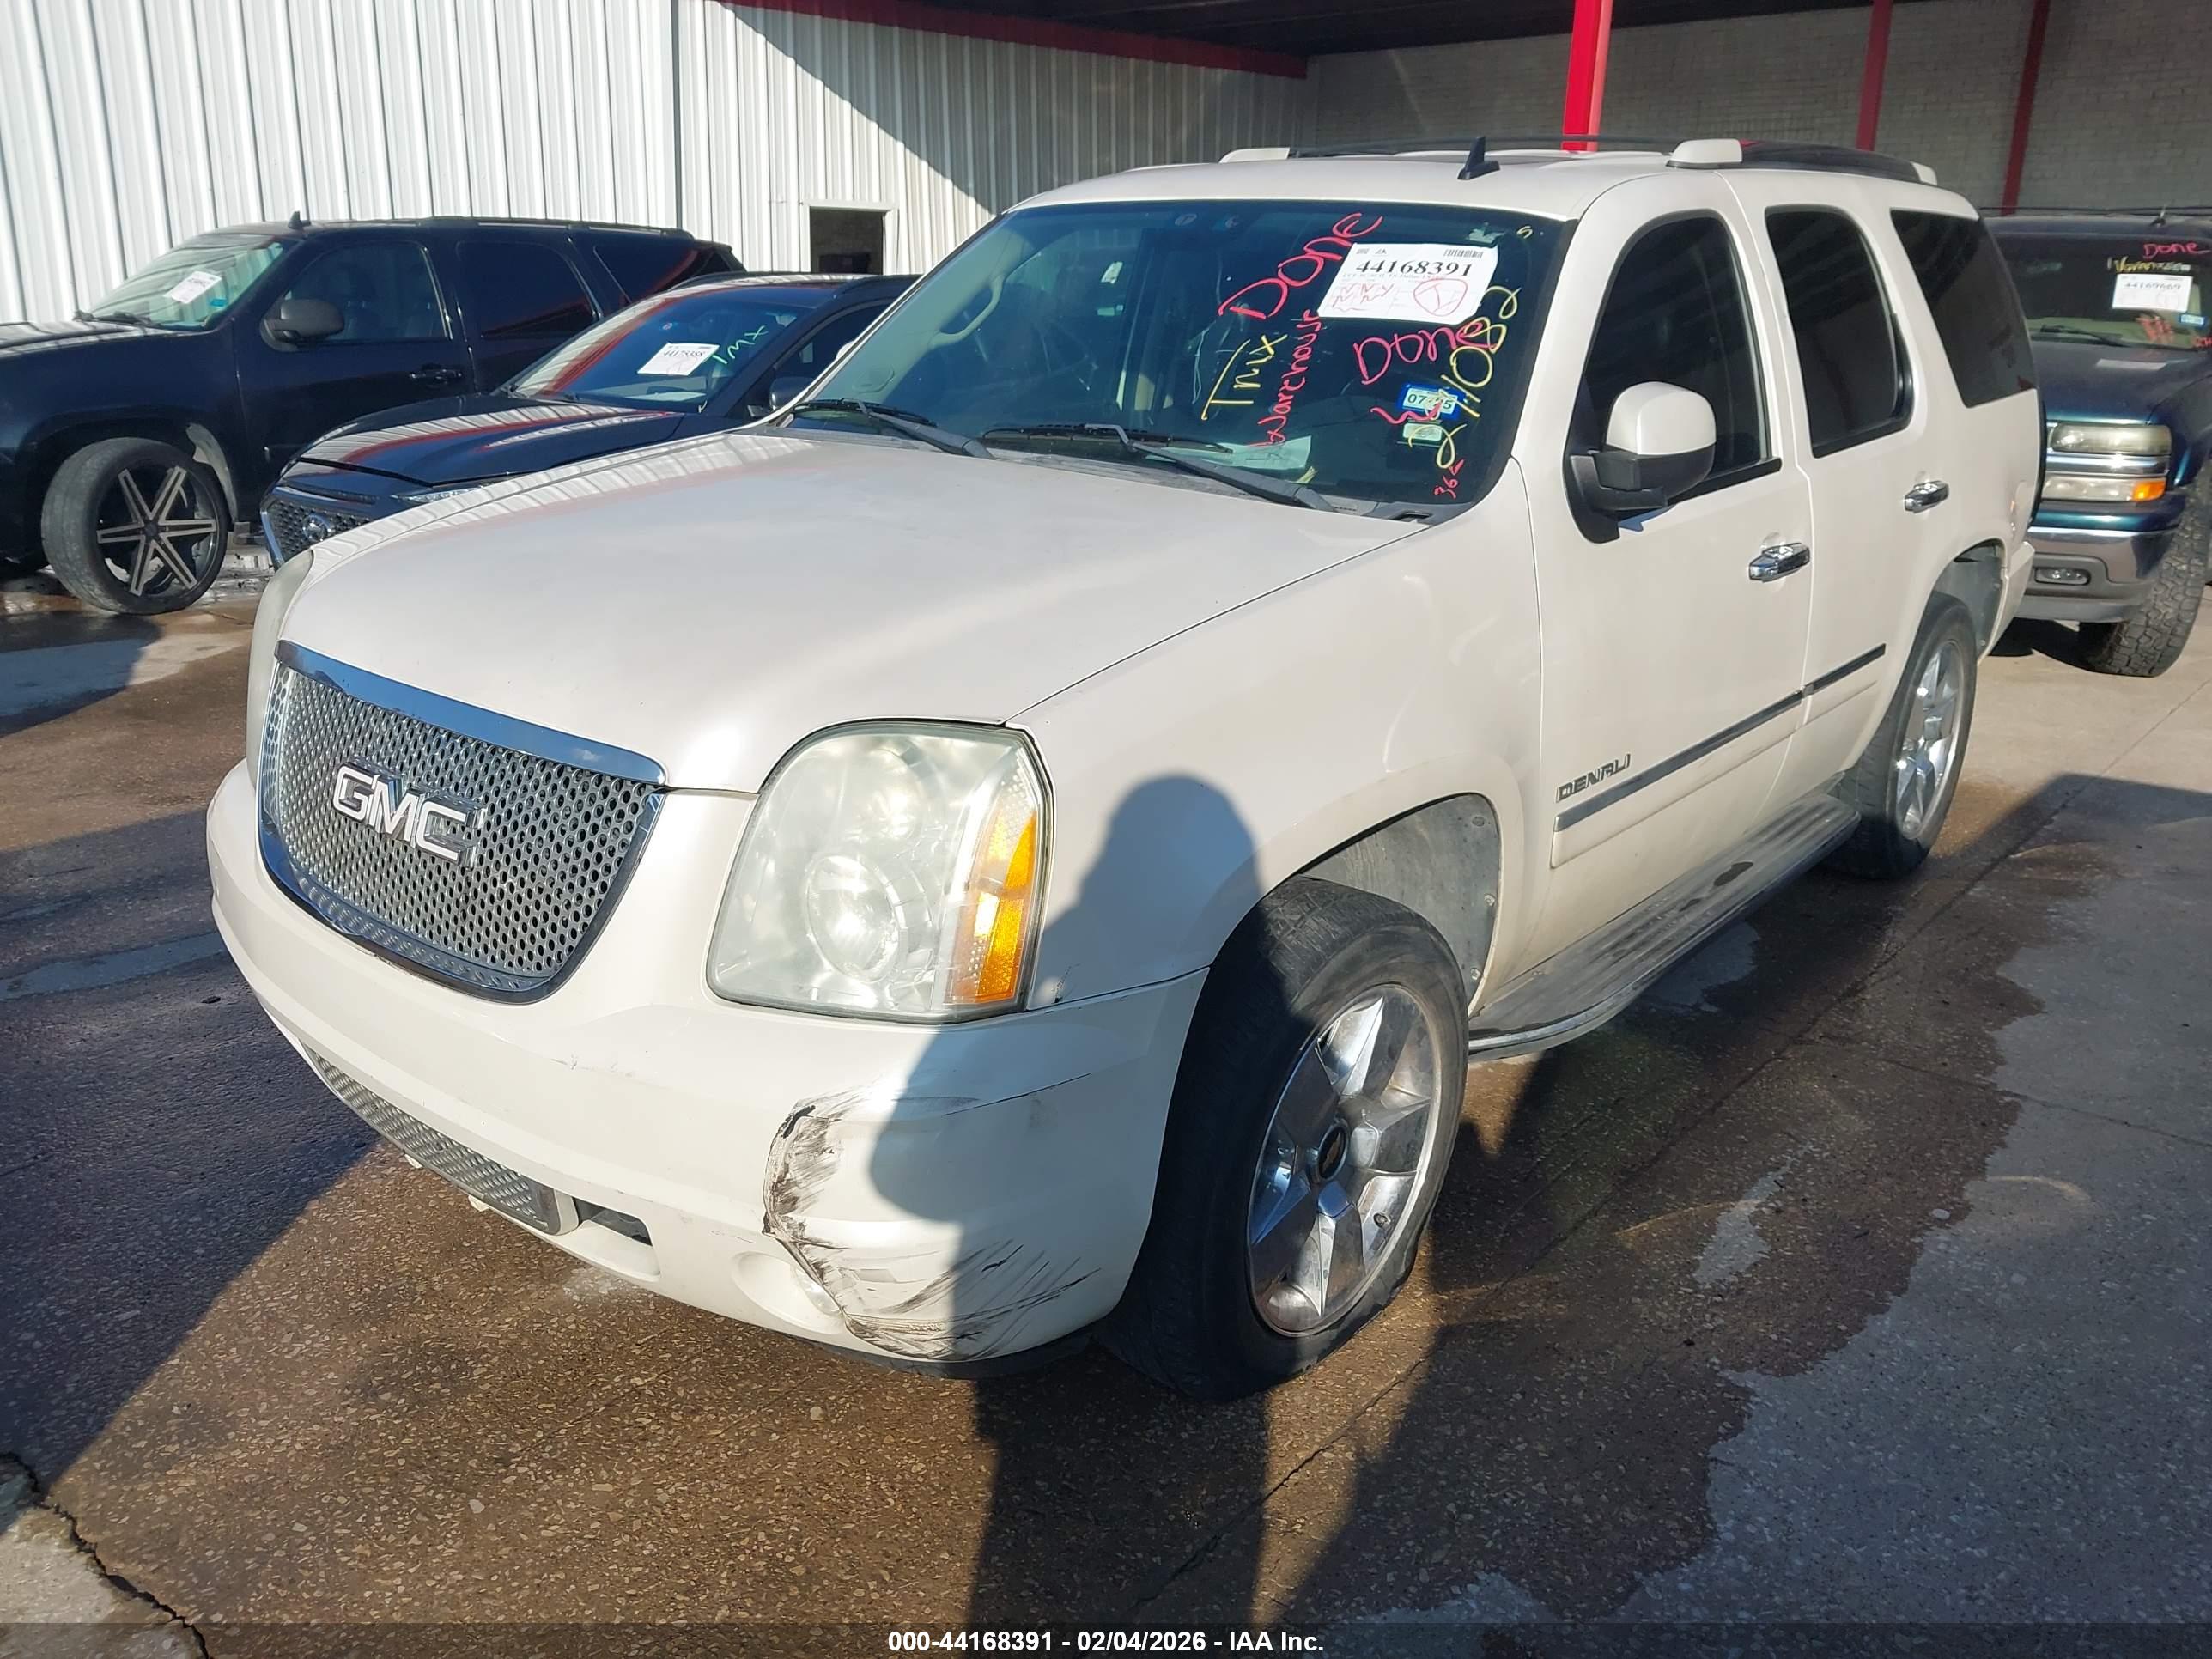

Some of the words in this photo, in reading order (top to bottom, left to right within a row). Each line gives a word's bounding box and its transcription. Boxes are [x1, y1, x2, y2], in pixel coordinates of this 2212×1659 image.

[1218, 212, 1383, 321] Done
[1355, 259, 1474, 277] 44168391
[1352, 319, 1496, 386] Done
[1555, 753, 1632, 804] DENALI
[332, 762, 481, 866] GMC
